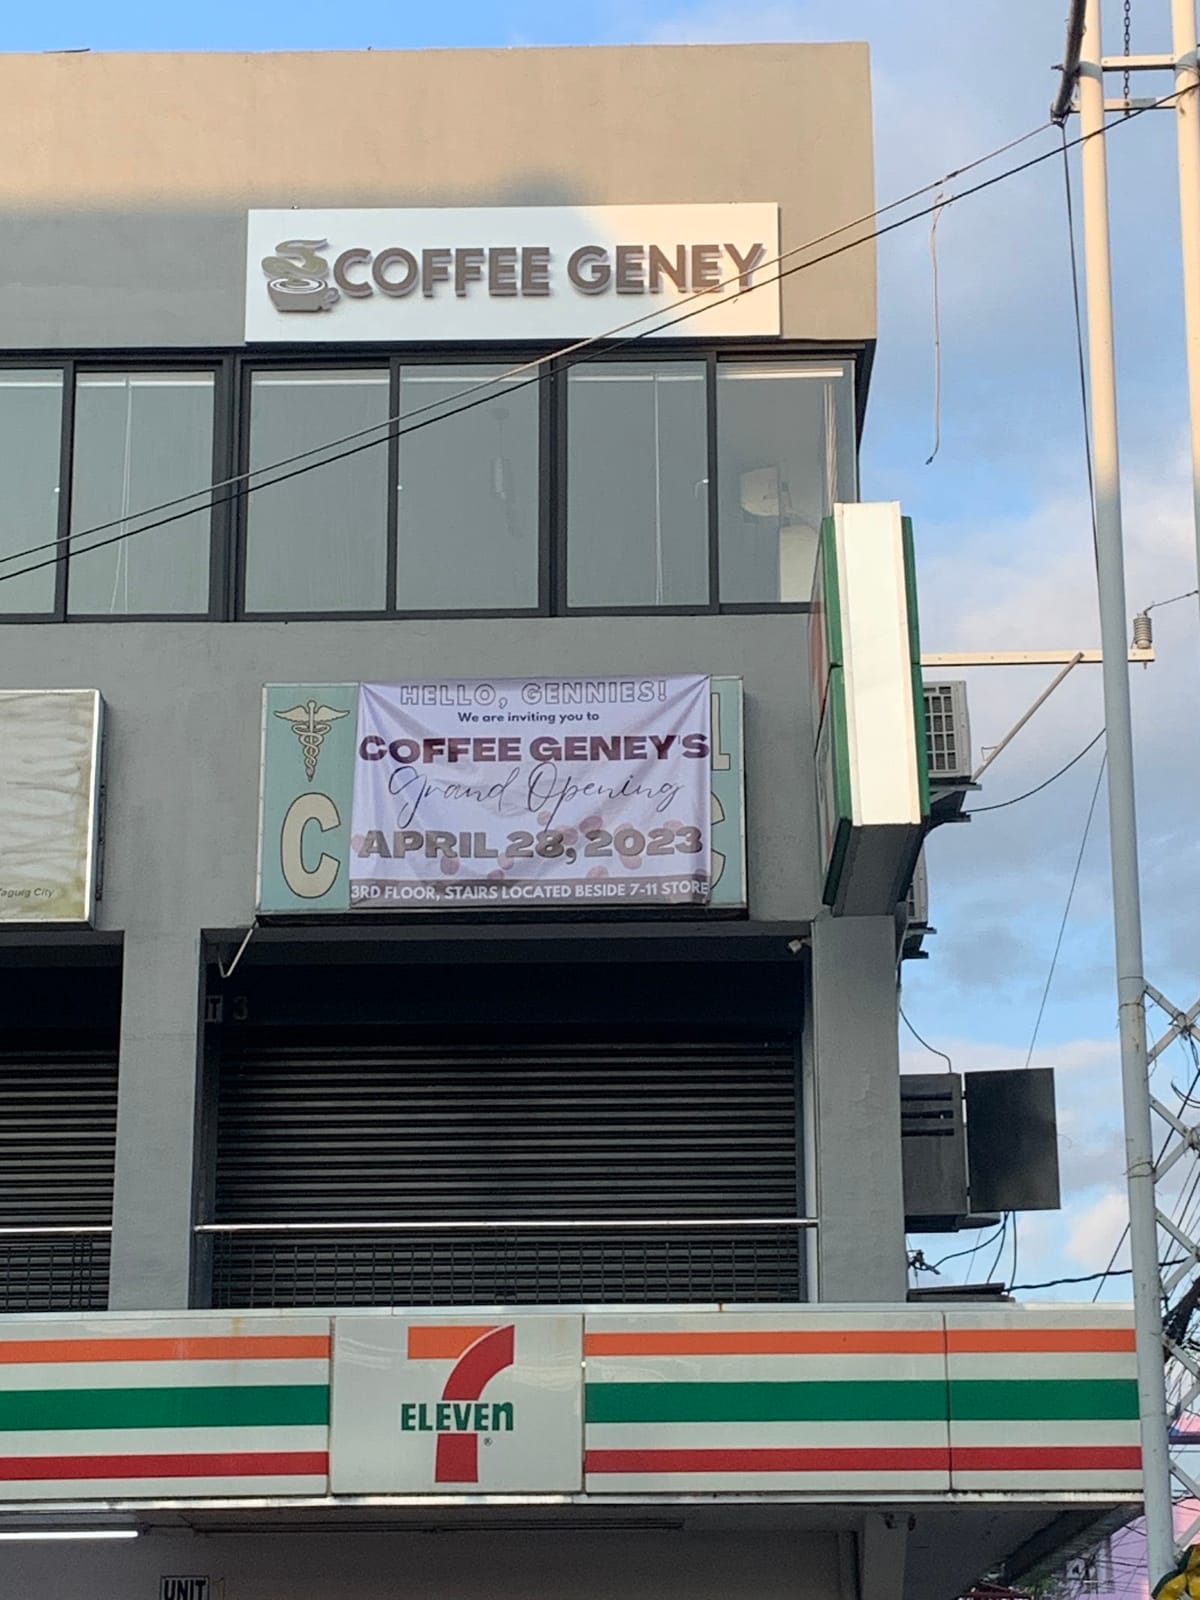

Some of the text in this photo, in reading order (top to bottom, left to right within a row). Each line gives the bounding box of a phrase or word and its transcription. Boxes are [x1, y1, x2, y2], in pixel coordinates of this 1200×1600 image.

[333, 243, 765, 298] COFFEE GENEY
[401, 680, 667, 709] HELLO, GENNIES!
[458, 711, 599, 724] We are inviting you to
[359, 733, 709, 764] COFFEE GENEY'S
[388, 762, 685, 833] Grand Opening
[357, 826, 703, 865] APRIL 28, 2023
[34, 888, 55, 897] City
[351, 880, 709, 901] 3RD FLOOR, STAIRS LOCATED BESIDE 7-11 STORE
[407, 1324, 515, 1483] 7
[164, 1579, 206, 1600] UNIT
